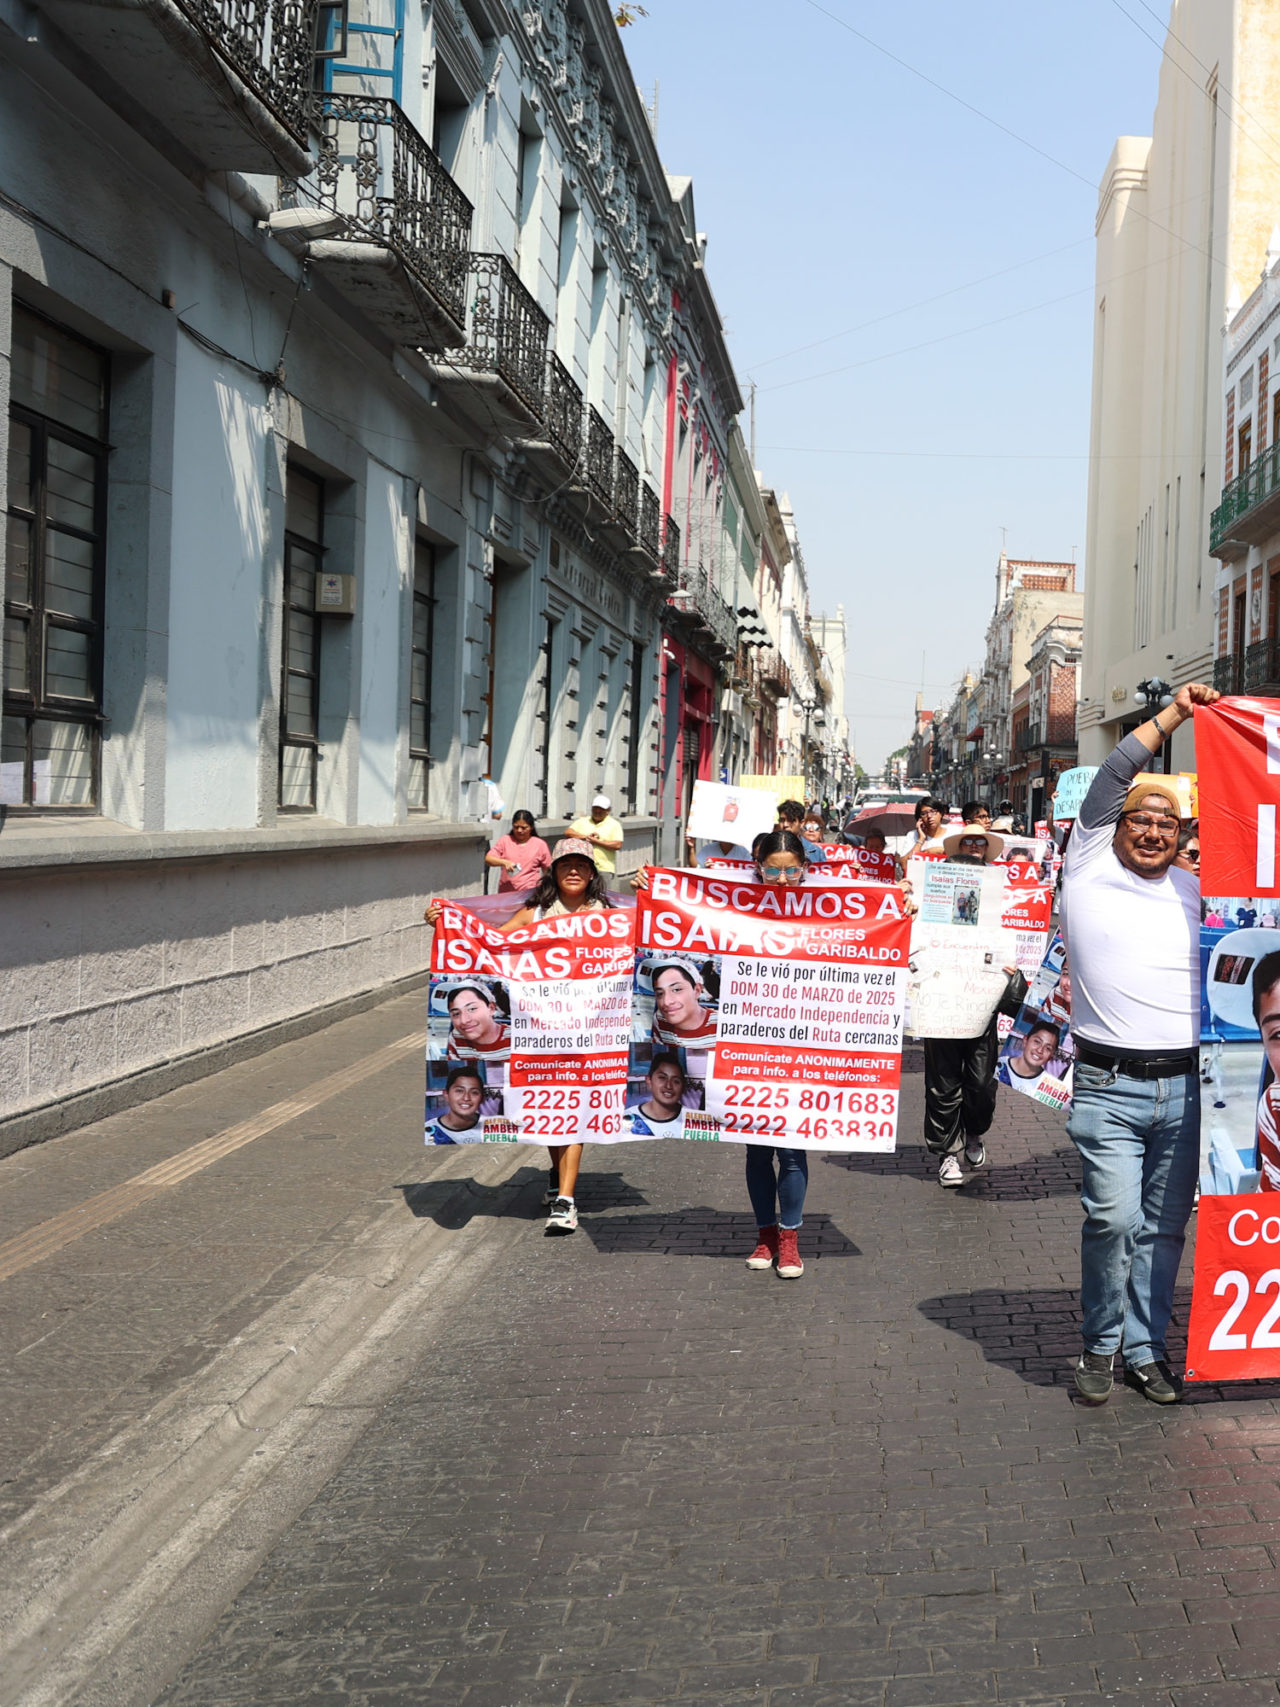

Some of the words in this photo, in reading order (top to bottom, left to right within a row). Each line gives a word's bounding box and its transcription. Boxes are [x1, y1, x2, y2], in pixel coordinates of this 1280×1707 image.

[883, 855, 894, 866] A
[838, 864, 852, 879] A
[1024, 865, 1038, 880] A
[956, 876, 980, 886] Flores
[651, 873, 865, 919] BUSCAMOS
[875, 894, 901, 920] A
[1033, 888, 1047, 904] A
[443, 906, 631, 946] BUSCAMOS
[801, 927, 865, 941] FLORES
[436, 939, 571, 978] ISAÍAS
[575, 947, 632, 959] FLORES
[807, 942, 900, 961] GARIBALDO
[737, 962, 751, 976] Se
[756, 962, 767, 977] le
[772, 962, 789, 978] vió
[794, 966, 815, 982] por
[819, 965, 859, 984] última
[864, 972, 883, 985] vez
[885, 972, 895, 986] el
[539, 984, 550, 997] le
[730, 980, 758, 997] DOM
[762, 982, 778, 998] 30
[782, 983, 798, 999] de
[801, 986, 843, 1002] MARZO
[847, 989, 863, 1004] de
[867, 990, 895, 1006] 2025
[518, 999, 539, 1013] DOM
[618, 996, 628, 1008] de
[514, 1018, 528, 1029] en
[722, 1002, 737, 1015] en
[742, 1002, 796, 1019] Mercado
[800, 1005, 889, 1025] Independencia
[893, 1014, 900, 1029] y
[998, 1019, 1013, 1032] 63
[514, 1035, 572, 1049] paraderos
[577, 1033, 592, 1046] del
[595, 1034, 613, 1046] Ruta
[721, 1022, 785, 1039] paraderos
[789, 1026, 808, 1040] del
[812, 1027, 841, 1042] Ruta
[845, 1031, 899, 1046] cercanas
[795, 1055, 895, 1069] ANONIMAMENTE
[527, 1073, 552, 1082] para
[555, 1072, 579, 1081] info.
[591, 1071, 605, 1080] los
[733, 1066, 759, 1076] para
[763, 1065, 789, 1077] info.
[792, 1069, 799, 1077] a
[803, 1069, 820, 1079] los
[824, 1070, 881, 1083] teléfonos:
[1037, 1081, 1070, 1102] AMBER
[522, 1090, 580, 1110] 2225
[724, 1085, 789, 1109] 2225
[799, 1090, 895, 1115] 801683
[1034, 1091, 1063, 1110] PUEBLA
[685, 1111, 712, 1121] ALERTA
[483, 1124, 518, 1134] AMBER
[522, 1115, 578, 1135] 2222
[586, 1114, 621, 1134] 463
[684, 1119, 720, 1132] AMBER
[724, 1113, 787, 1136] 2222
[796, 1117, 893, 1140] 463830
[483, 1134, 517, 1143] PUEBLA
[683, 1130, 720, 1141] PUEBLA
